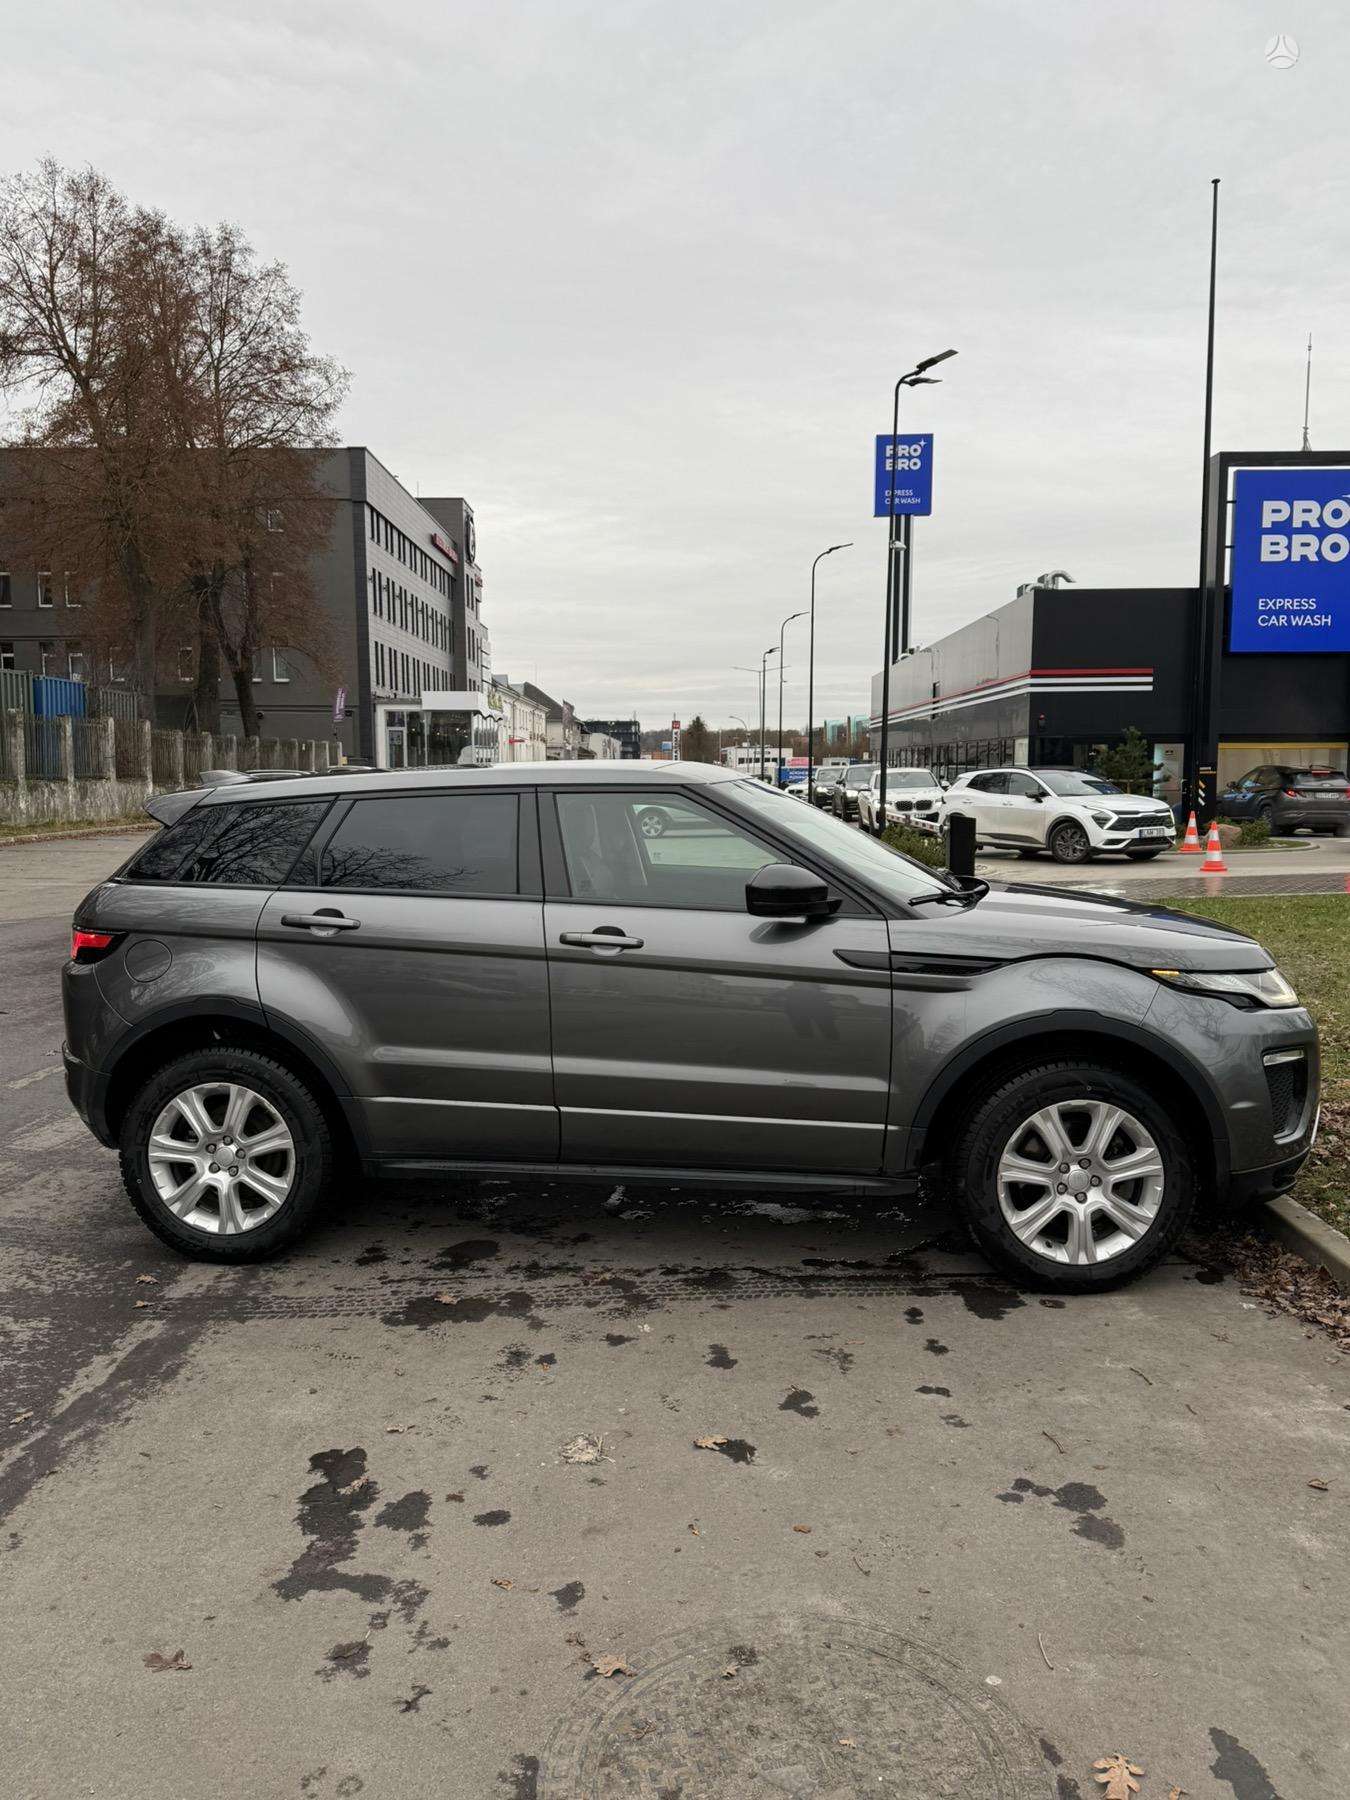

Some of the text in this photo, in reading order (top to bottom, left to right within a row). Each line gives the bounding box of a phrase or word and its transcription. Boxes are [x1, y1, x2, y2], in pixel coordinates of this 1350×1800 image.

[1262, 500, 1350, 528] PRO
[1260, 533, 1350, 562] BRO
[1258, 599, 1316, 610] EXPRESS
[1258, 615, 1331, 626] CAR WASH
